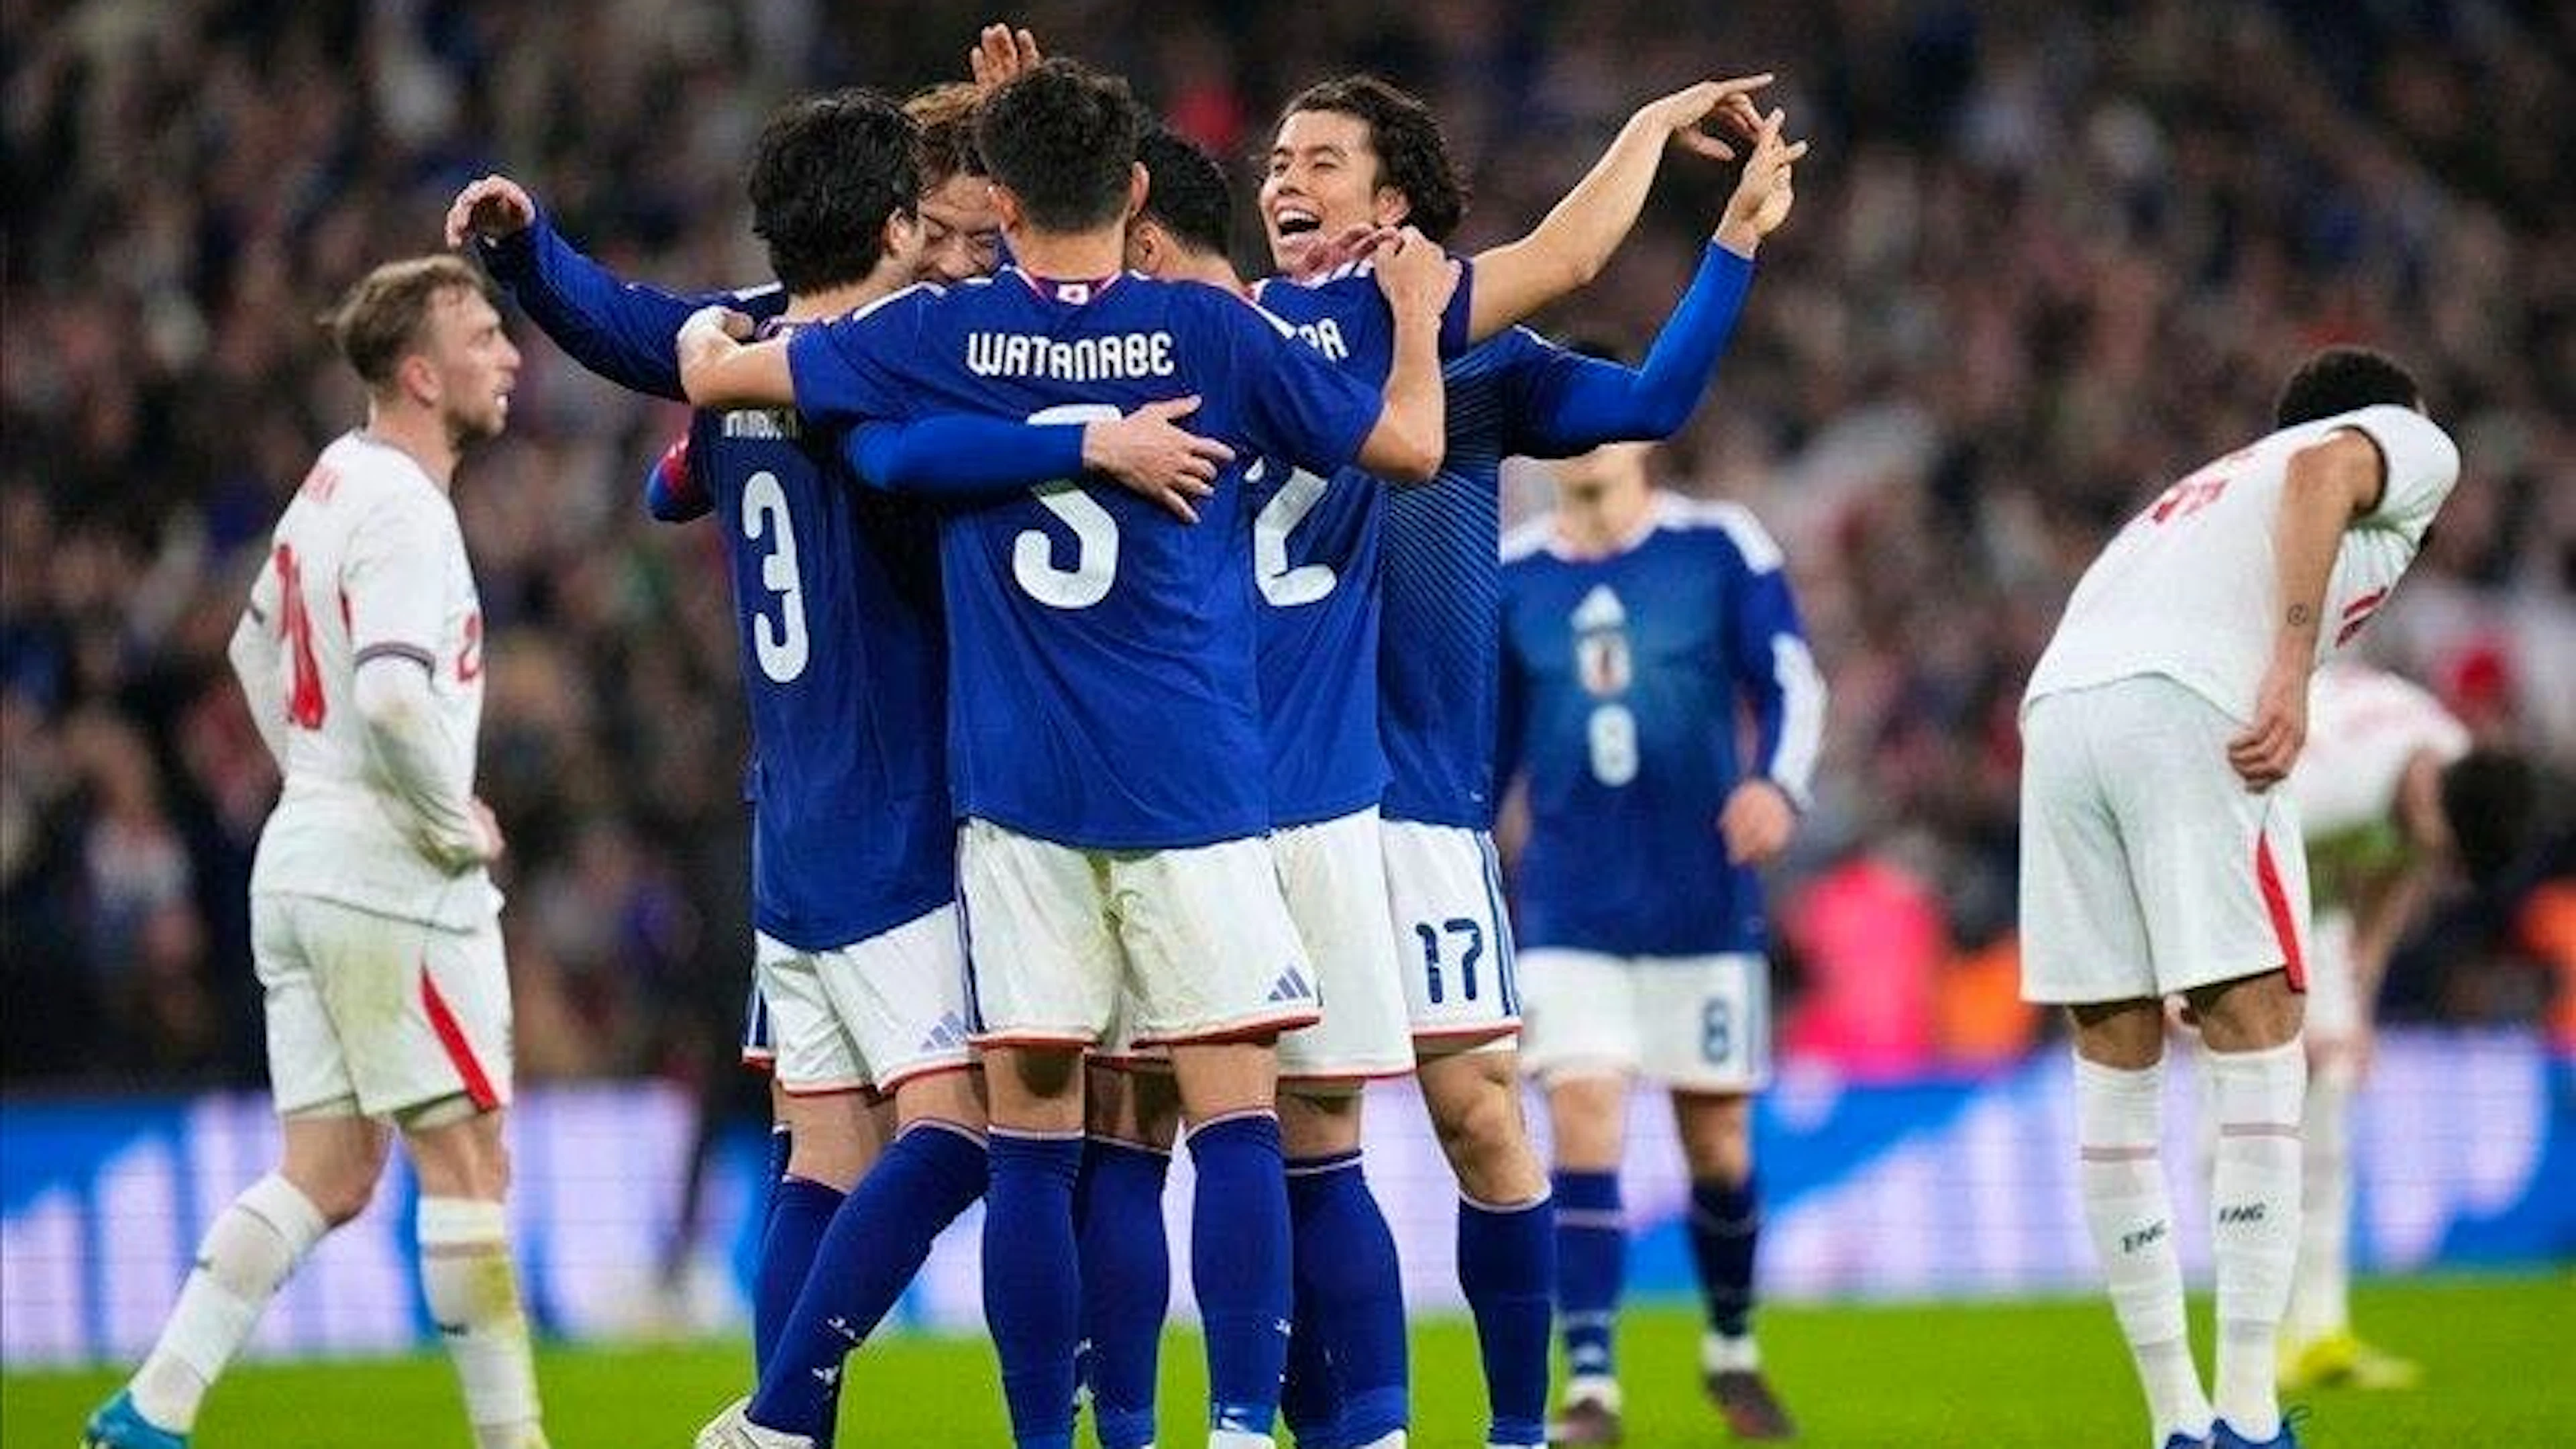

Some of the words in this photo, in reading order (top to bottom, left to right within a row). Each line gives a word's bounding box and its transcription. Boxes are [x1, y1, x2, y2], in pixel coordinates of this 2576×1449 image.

[966, 333, 1175, 382] WATANABE
[742, 470, 809, 683] 3
[1589, 703, 1638, 788] 8
[1415, 918, 1483, 1002] 17
[1703, 999, 1731, 1063] 8
